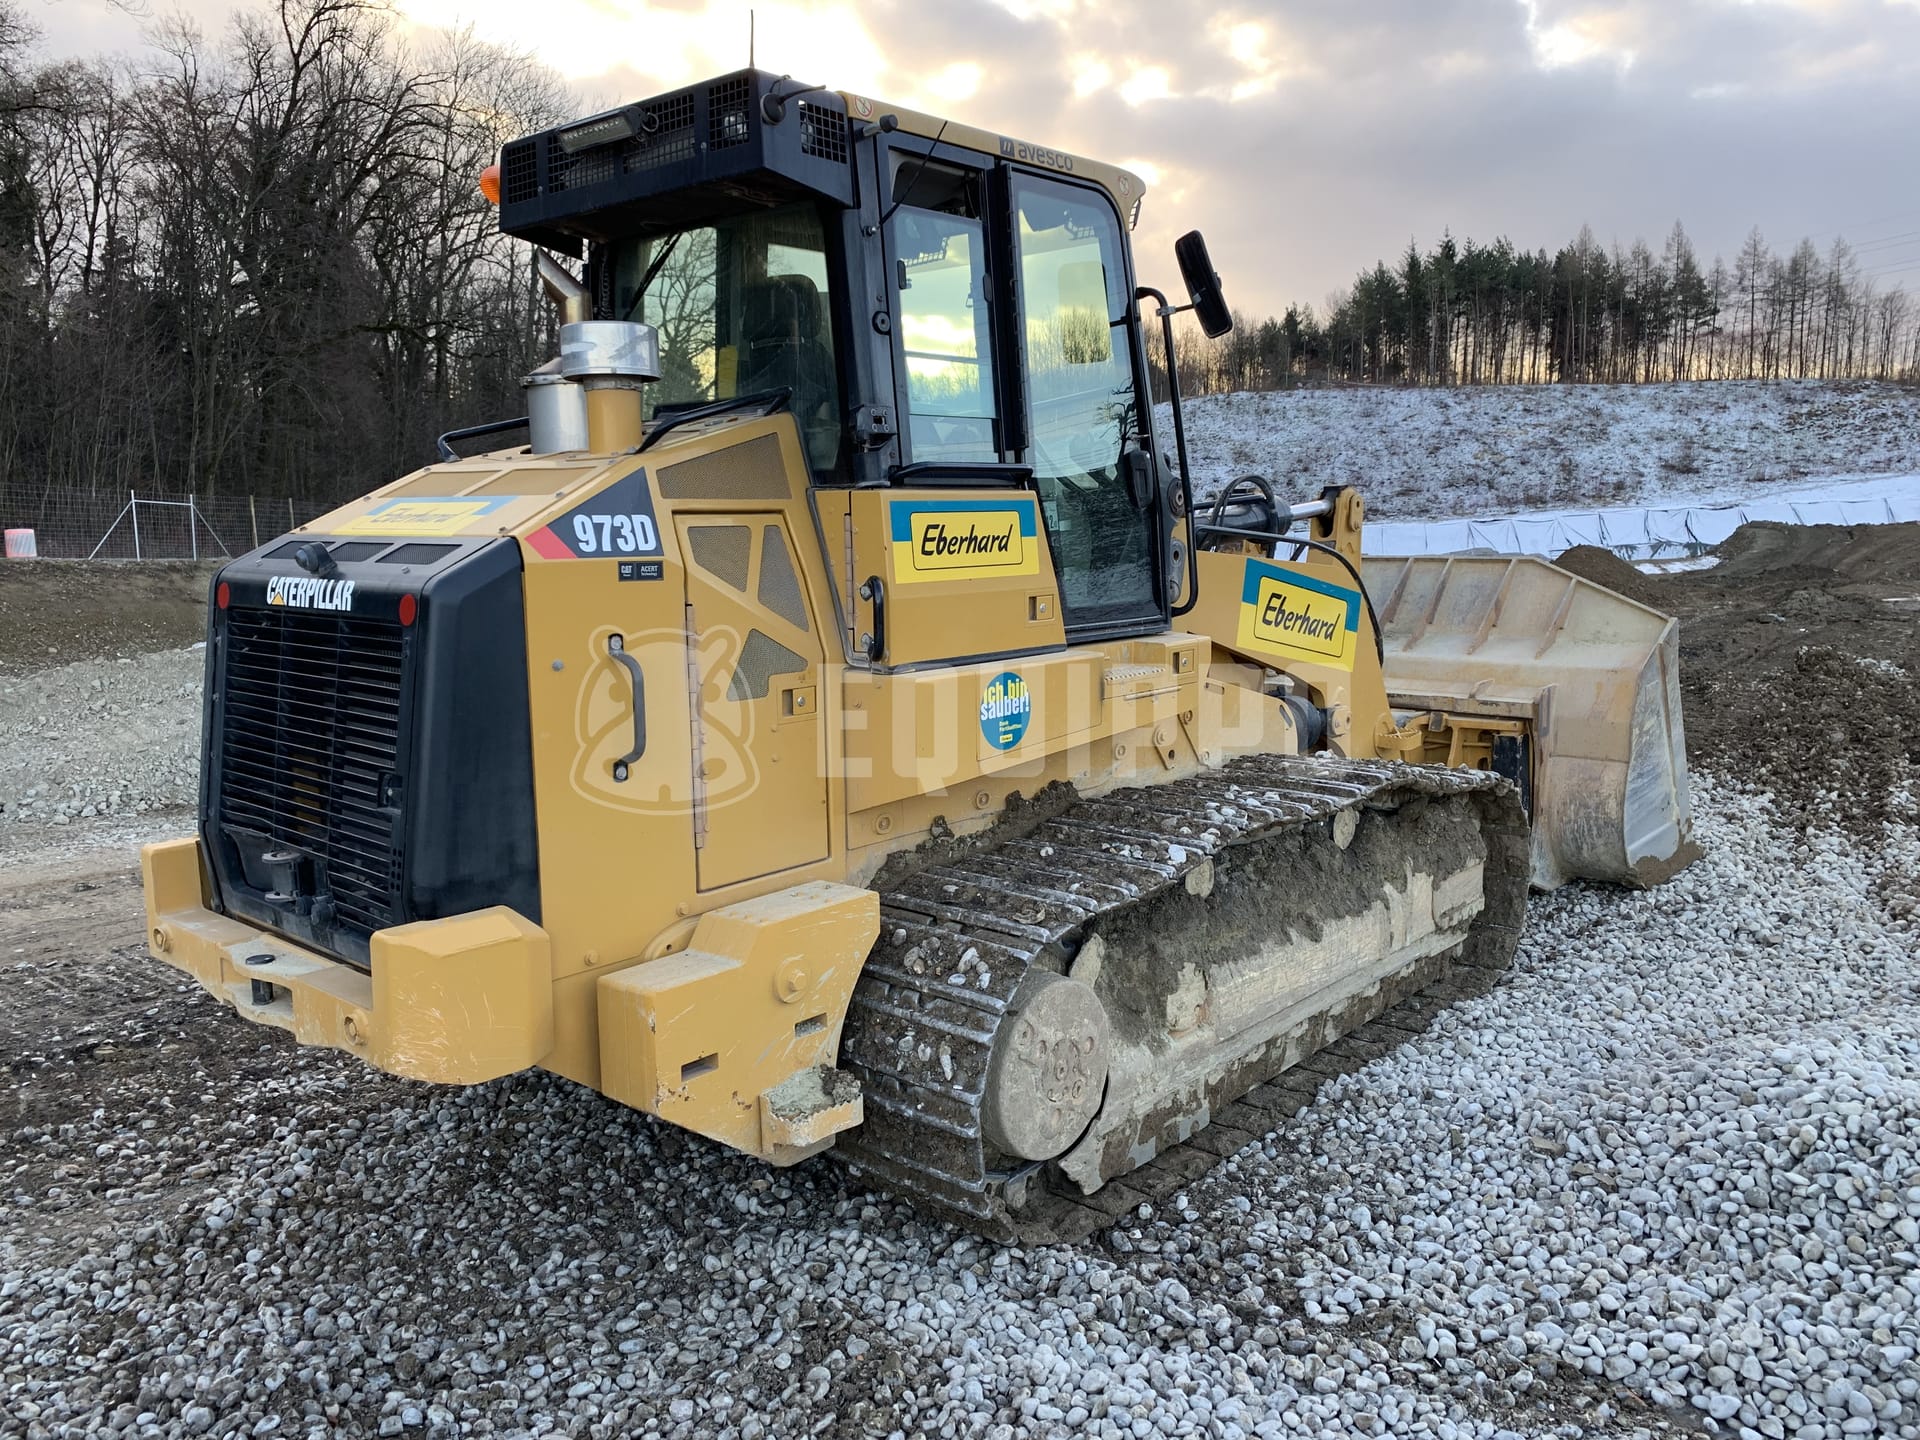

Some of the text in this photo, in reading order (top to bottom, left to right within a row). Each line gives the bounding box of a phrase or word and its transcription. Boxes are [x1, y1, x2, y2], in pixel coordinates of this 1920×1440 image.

[1018, 143, 1073, 171] avesco
[573, 514, 657, 552] 973D
[921, 524, 1013, 556] Eberhard
[267, 576, 355, 611] CATERPILLAR
[1262, 592, 1341, 641] Eberhard
[1007, 678, 1027, 699] bin
[980, 692, 1030, 721] sauber!
